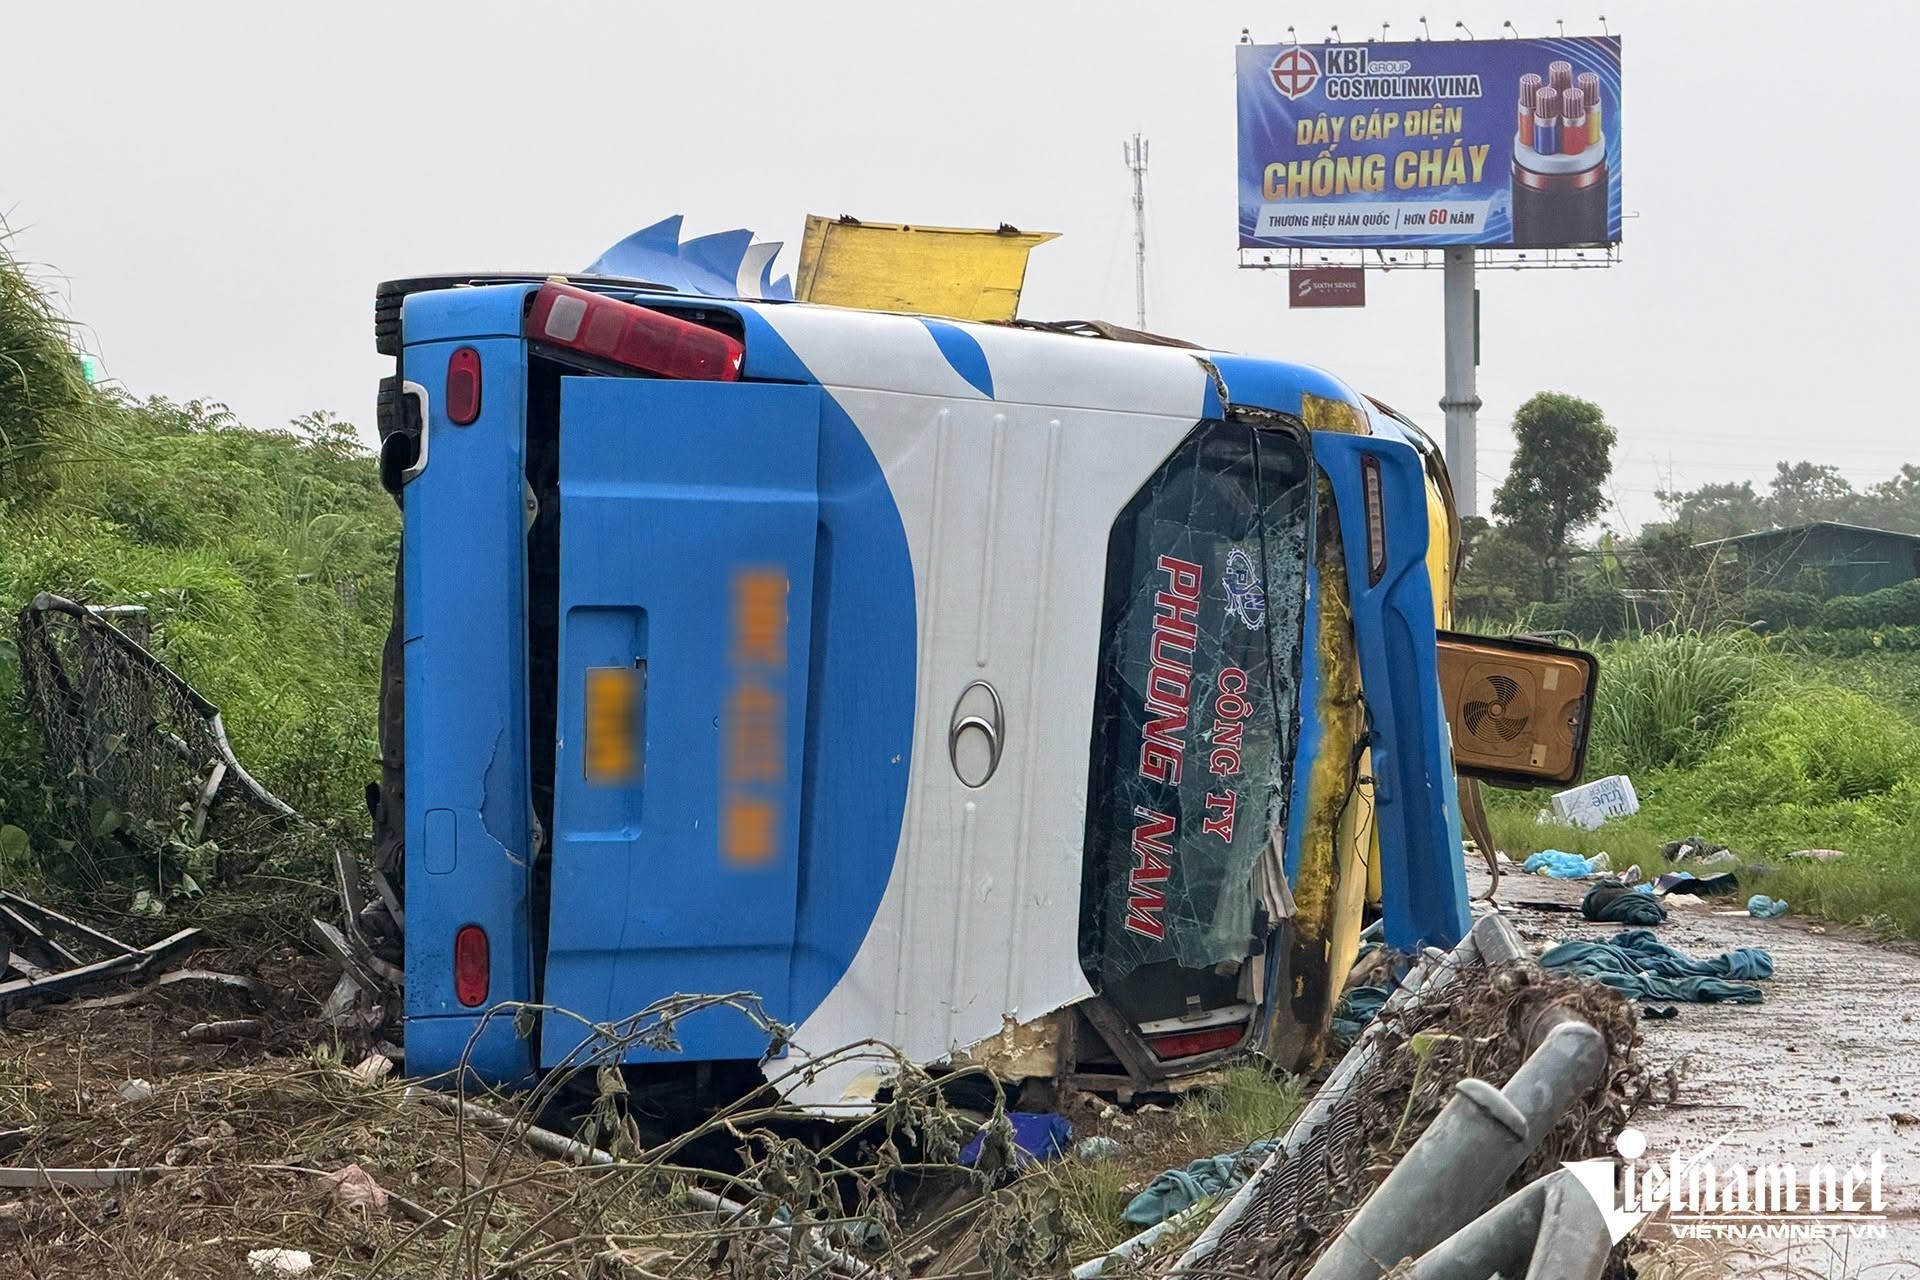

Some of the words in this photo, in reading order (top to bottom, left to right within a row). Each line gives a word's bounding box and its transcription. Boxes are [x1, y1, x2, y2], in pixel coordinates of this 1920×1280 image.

[1327, 48, 1367, 75] KBI
[1369, 61, 1410, 73] GROUP
[1327, 78, 1433, 99] COSMOLINK
[1439, 76, 1481, 96] VINA
[1297, 112, 1345, 146] DÂY
[1350, 107, 1400, 141] CÁP
[1404, 103, 1463, 140] ĐIỆN
[1262, 144, 1386, 202] CHỐNG
[1394, 138, 1490, 190] CHÁY
[1269, 214, 1309, 227] THƯƠNG
[1311, 212, 1336, 229] HIỆU
[1338, 212, 1360, 226] HÀN
[1362, 210, 1390, 227] QUỐC
[1404, 212, 1426, 226] HƠN
[1428, 208, 1447, 225] 60
[1450, 210, 1475, 225] NĂM
[1313, 281, 1333, 289] SIXTH
[1334, 281, 1357, 289] SENSE
[1208, 667, 1254, 777] CÔNG
[1591, 789, 1622, 808] true
[1202, 789, 1238, 844] TY
[1124, 806, 1178, 943] NAM
